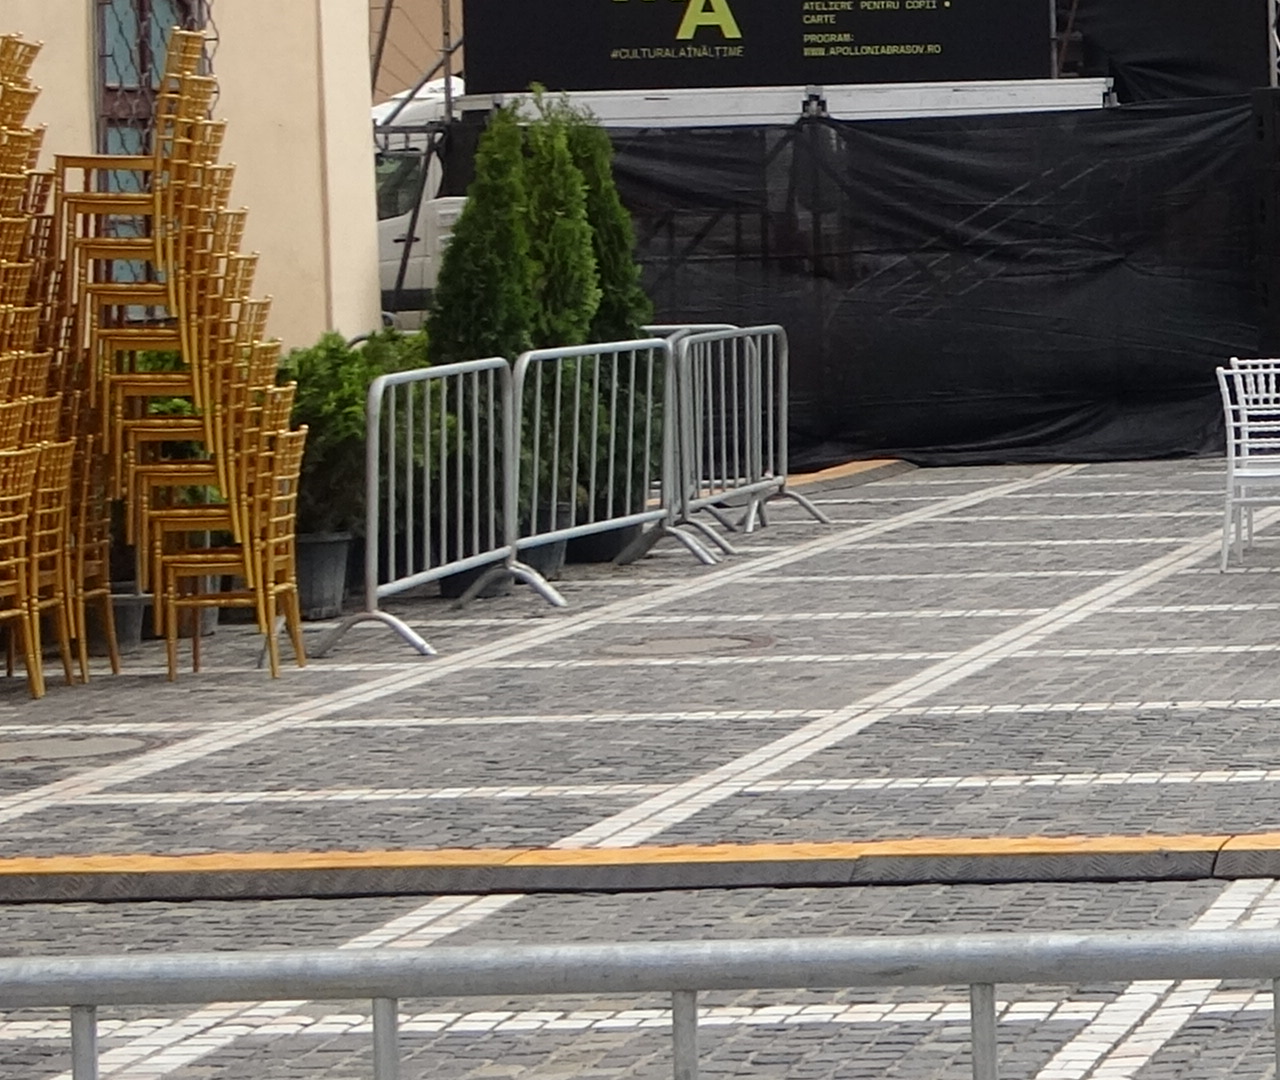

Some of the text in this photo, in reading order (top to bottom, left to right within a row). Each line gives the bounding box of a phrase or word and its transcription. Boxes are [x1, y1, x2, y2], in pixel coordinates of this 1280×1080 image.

[803, 0, 937, 11] ATELIERE PENTRU COPII
[803, 14, 836, 24] CARTE
